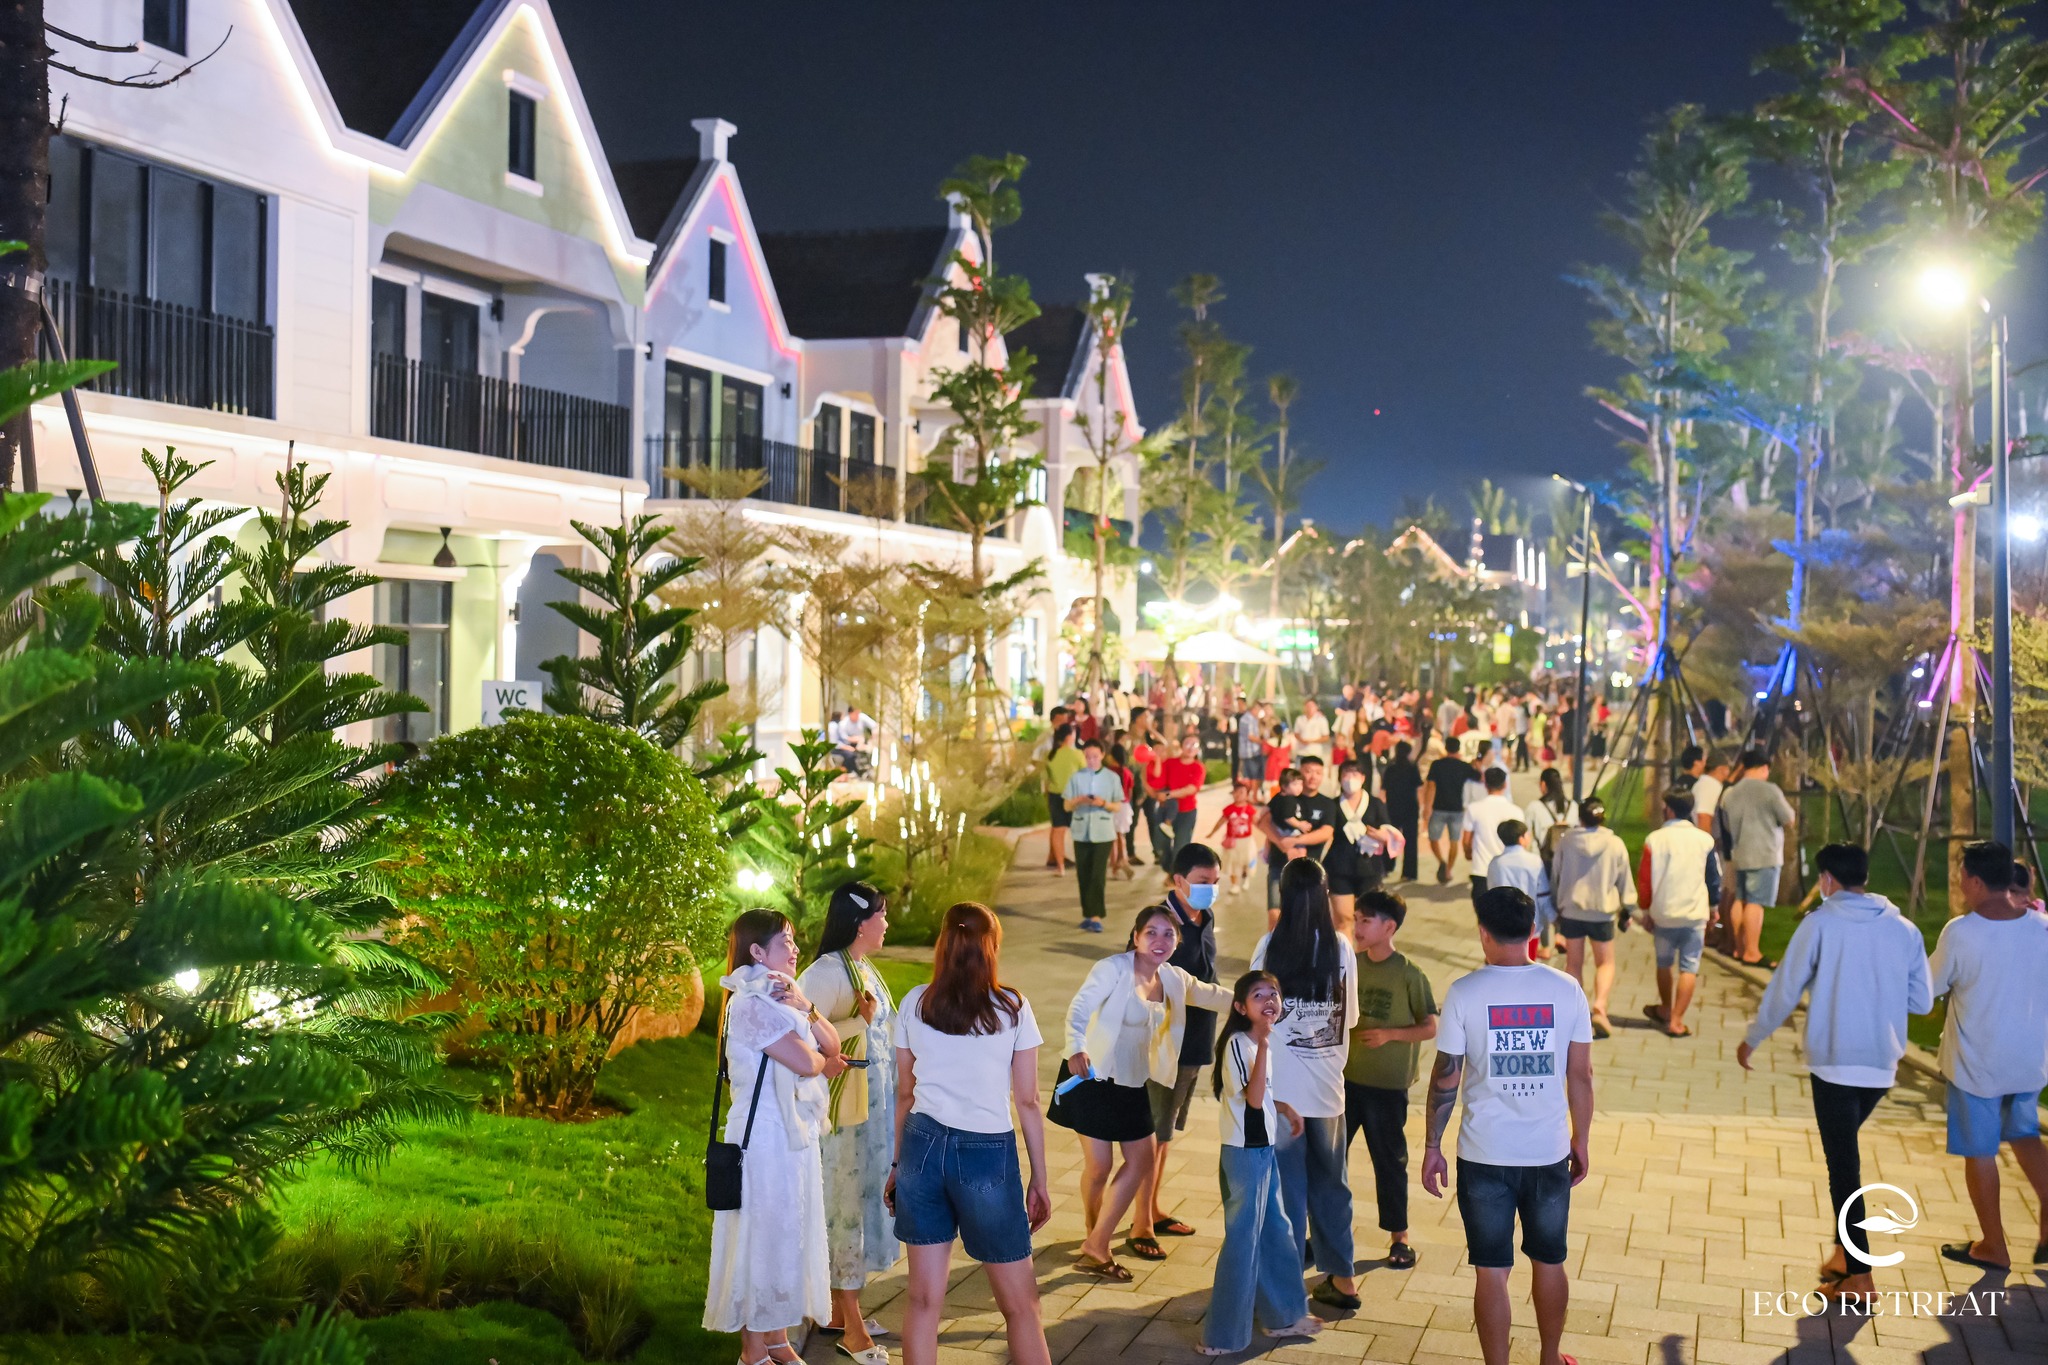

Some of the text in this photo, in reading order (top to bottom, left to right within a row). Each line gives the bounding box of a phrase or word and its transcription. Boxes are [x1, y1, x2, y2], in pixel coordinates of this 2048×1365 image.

[495, 688, 527, 706] WC
[1495, 1030, 1548, 1051] NEW
[1492, 1054, 1552, 1075] YORK
[1503, 1083, 1544, 1091] URBAN
